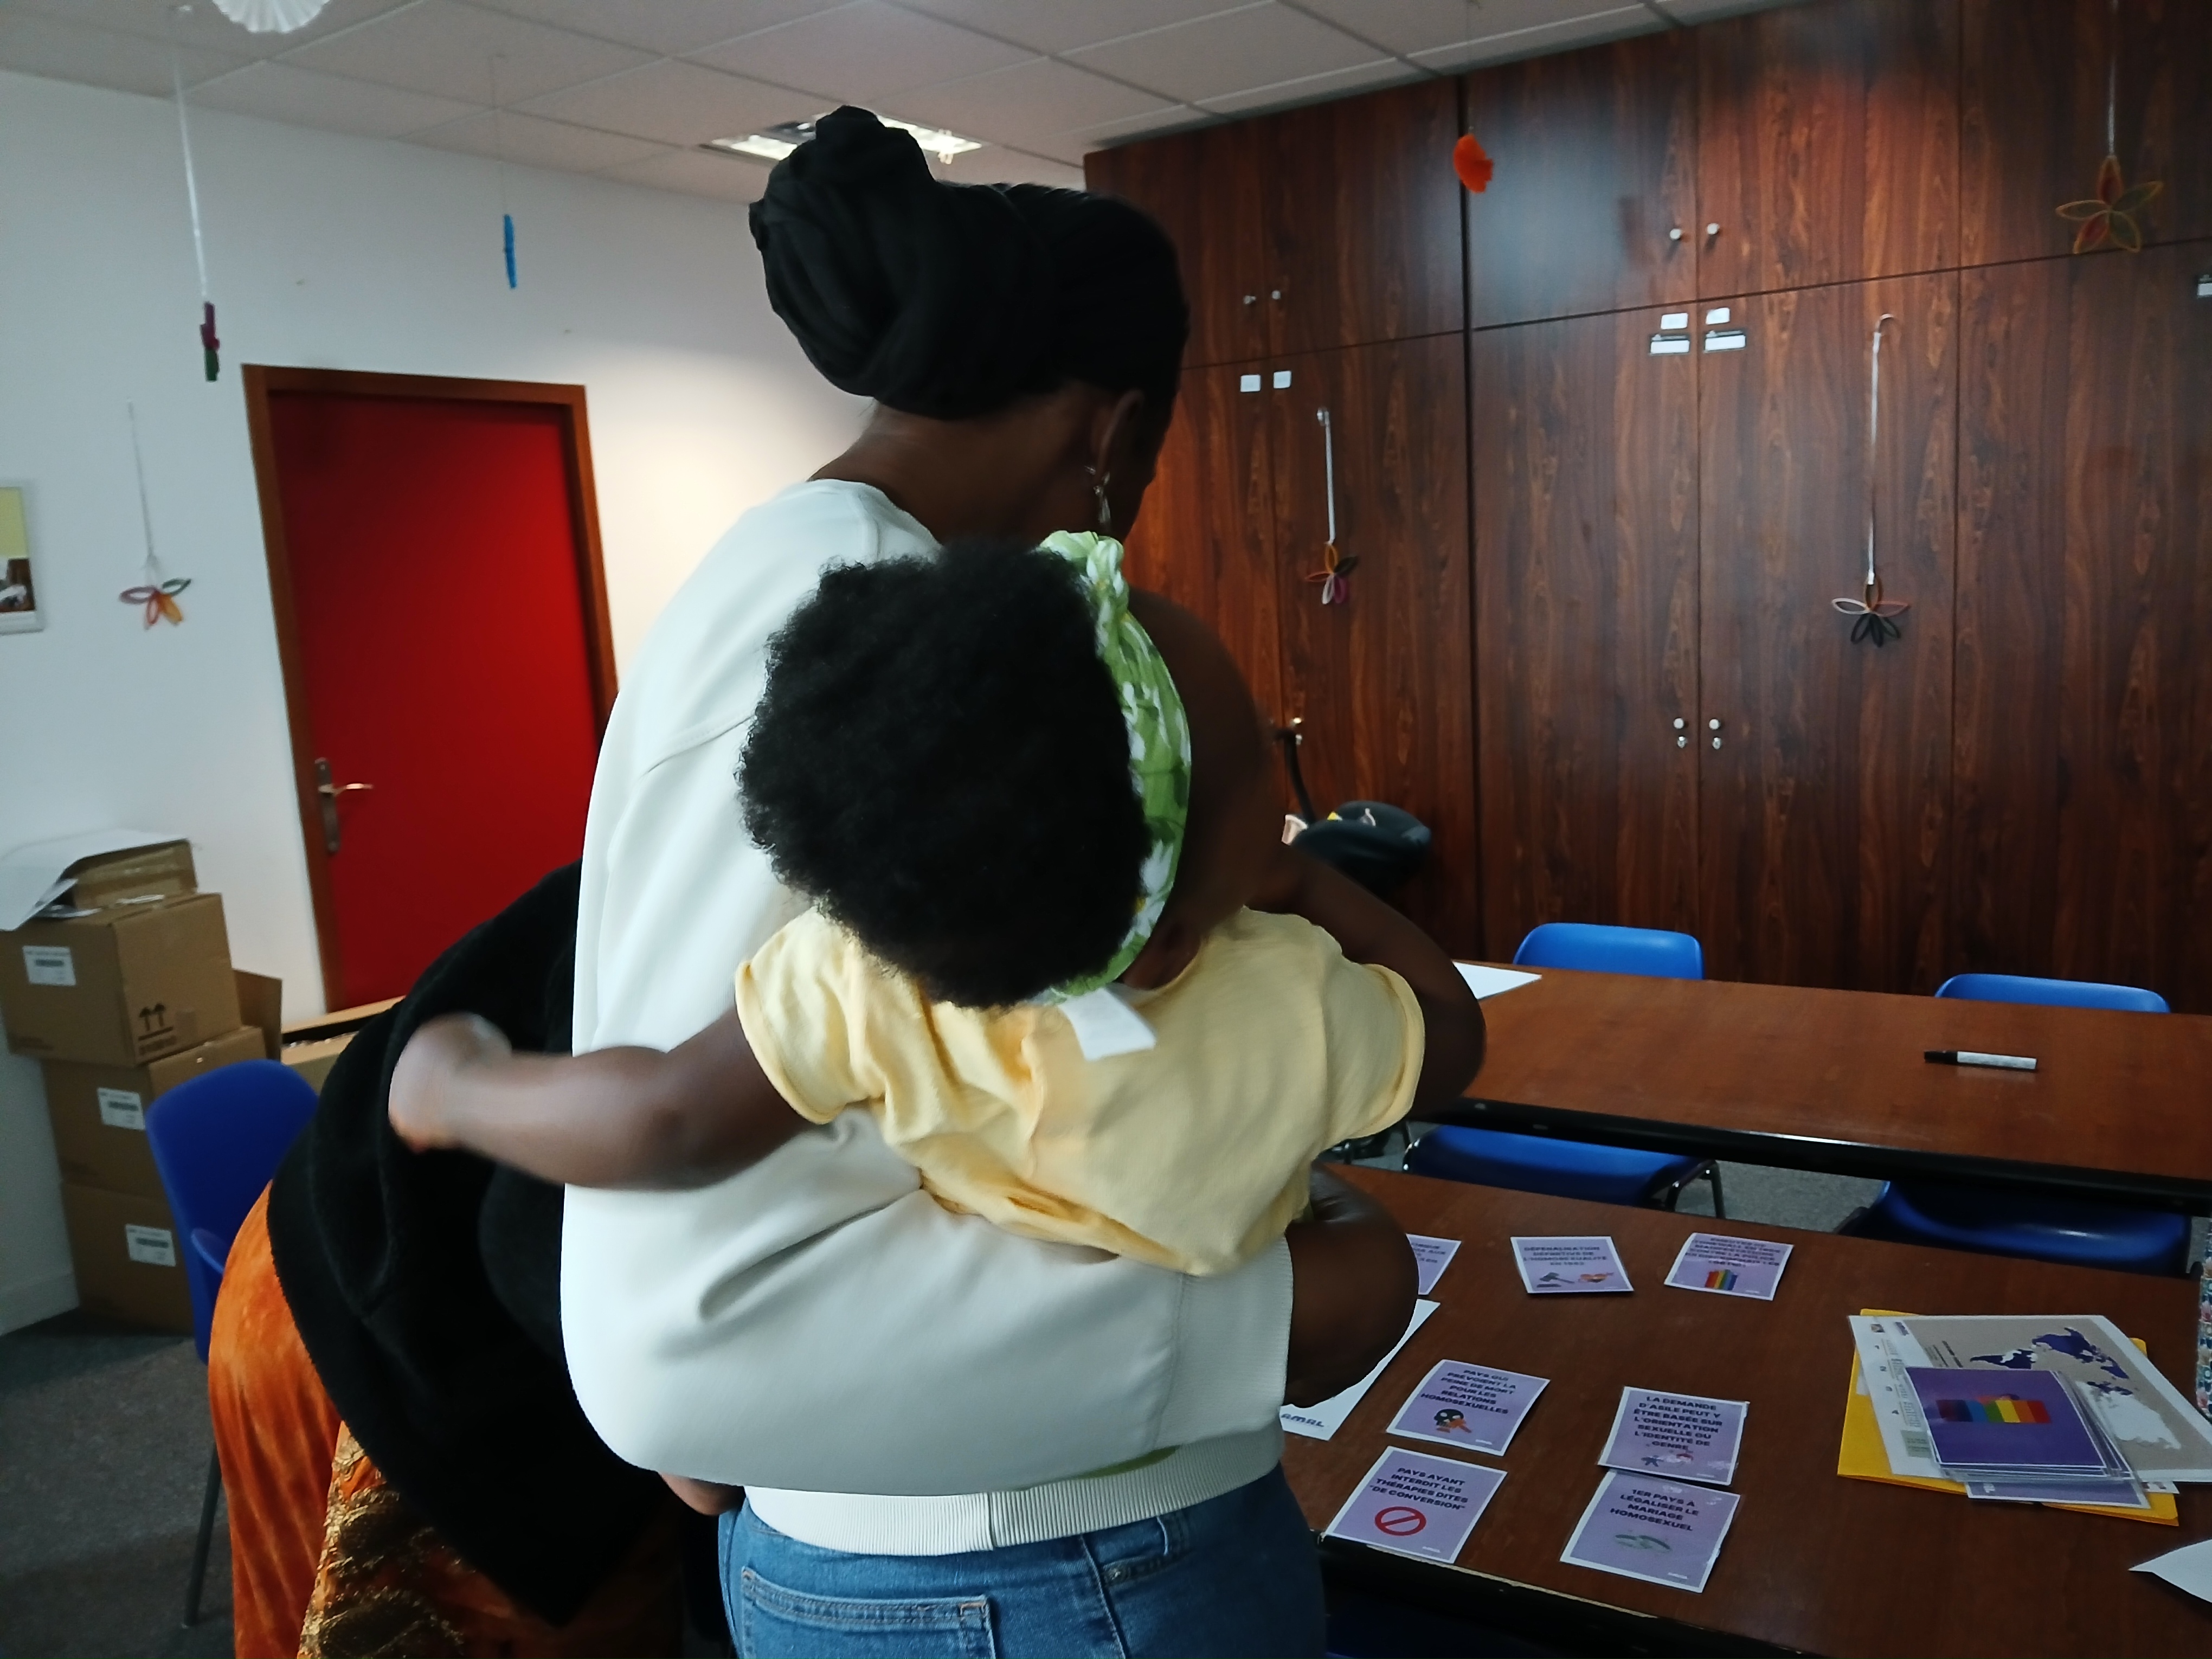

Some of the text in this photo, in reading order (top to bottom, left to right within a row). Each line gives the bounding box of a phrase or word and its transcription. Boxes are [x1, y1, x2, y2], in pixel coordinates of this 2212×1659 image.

[1441, 1377, 1468, 1386] PEINE
[1484, 1386, 1514, 1394] MORT
[1450, 1385, 1477, 1394] POUR
[1420, 1393, 1508, 1414] HOMOSEXUELLES
[1441, 1390, 1496, 1404] RELATIONS
[1663, 1398, 1716, 1410] DEMANDE
[1682, 1409, 1710, 1417] PEUT
[1634, 1416, 1719, 1433] L'ORIENTATION
[1638, 1424, 1692, 1436] SEXUELLE
[1651, 1441, 1688, 1450] GENRE
[1391, 1474, 1462, 1493] INTERDIT LES
[1397, 1468, 1465, 1486] PAYS AYANT
[1377, 1478, 1468, 1503] THÉRAPIES DITES
[1620, 1494, 1683, 1512] LÉGALISER
[1653, 1494, 1684, 1504] PAYS
[1610, 1508, 1693, 1532] HOMOSEXUEL
[1628, 1504, 1683, 1520] MARIAGE
